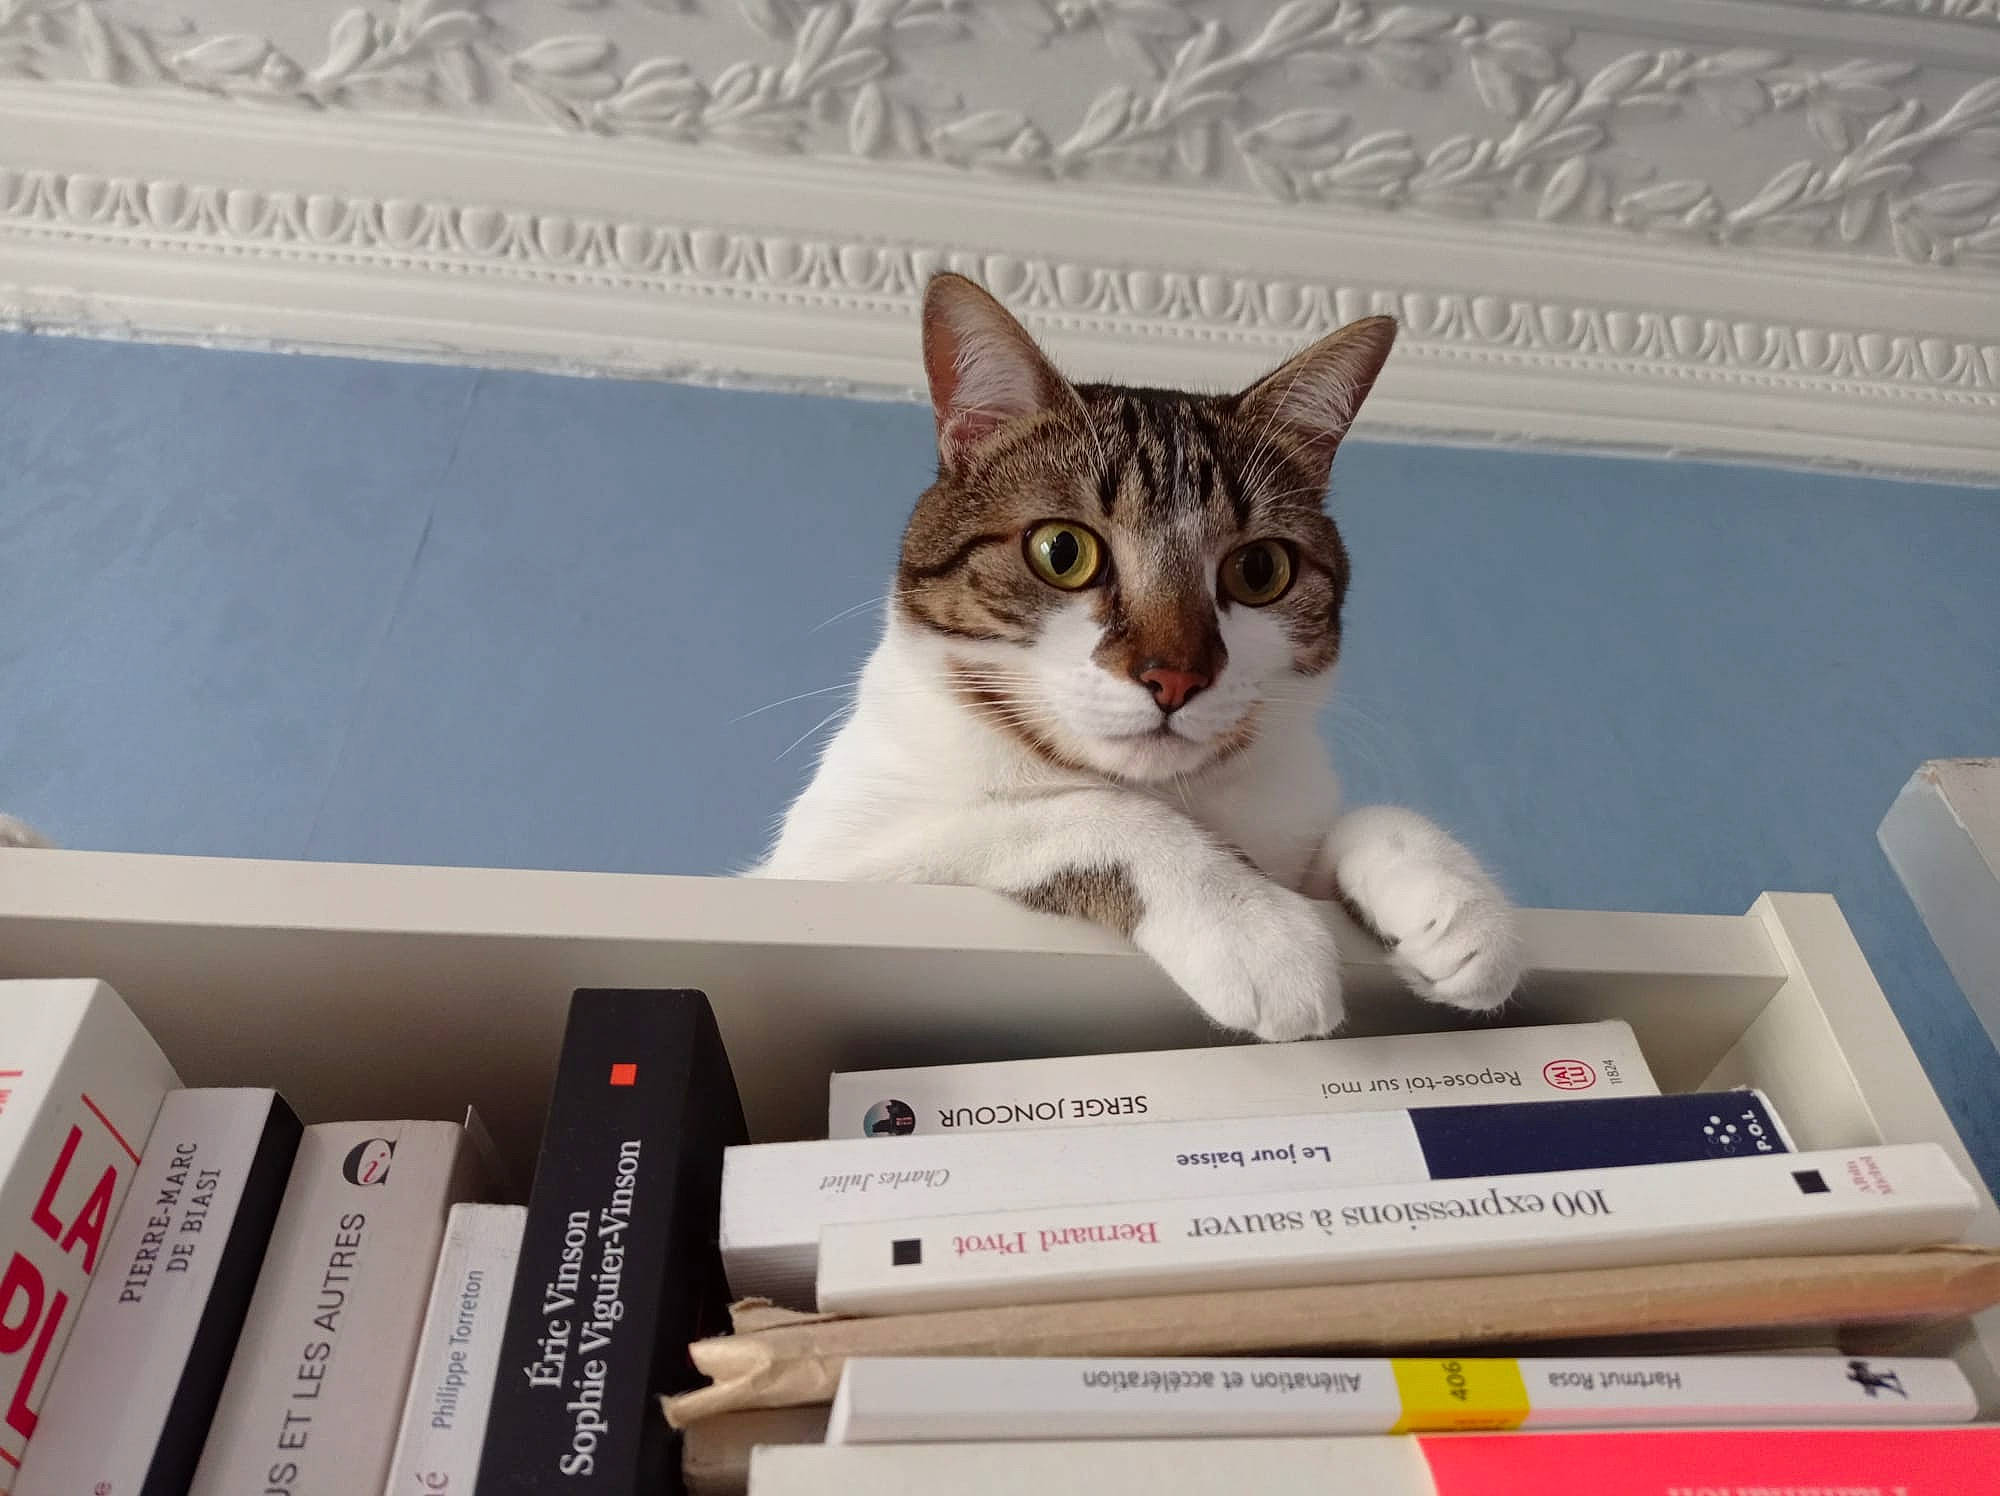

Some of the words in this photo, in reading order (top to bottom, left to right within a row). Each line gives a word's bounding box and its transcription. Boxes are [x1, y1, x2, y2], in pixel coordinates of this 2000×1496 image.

[1369, 1079, 1399, 1093] sur
[1406, 1070, 1522, 1091] Repose-toi
[1572, 1065, 1586, 1085] LU
[1601, 1060, 1624, 1085] 11824
[1322, 1079, 1362, 1099] moi
[940, 1098, 1065, 1128] JONCOUR
[1072, 1095, 1148, 1117] SERGE
[1176, 1149, 1245, 1170] baisse
[1251, 1144, 1297, 1164] jour
[1303, 1145, 1332, 1163] Le
[819, 1170, 874, 1191] Juliet
[878, 1167, 950, 1188] Charles
[1341, 1188, 1544, 1231] expressions
[1552, 1187, 1617, 1218] 100
[119, 1142, 197, 1305] PIERRE-MARC
[166, 1245, 195, 1273] DE
[181, 1168, 222, 1234] BIASI
[1186, 1208, 1305, 1237] sauver
[1311, 1209, 1333, 1236] à
[578, 1139, 643, 1355] Viguier-Vinson
[952, 1230, 1027, 1256] Pivot
[1039, 1221, 1159, 1252] Bernard
[314, 1213, 366, 1332] AUTRES
[544, 1209, 591, 1315] Vinson
[448, 1268, 485, 1346] Torreton
[523, 1319, 571, 1388] Éric
[293, 1342, 330, 1400] LES
[1083, 1371, 1214, 1392] accélération
[1222, 1371, 1243, 1389] et
[1252, 1370, 1361, 1393] Aliénation
[1441, 1360, 1468, 1402] 406
[1549, 1371, 1593, 1389] Rosa
[1599, 1370, 1682, 1390] Hartmut
[432, 1351, 468, 1430] Philippe
[278, 1409, 312, 1449] ET
[559, 1359, 608, 1477] Sophie
